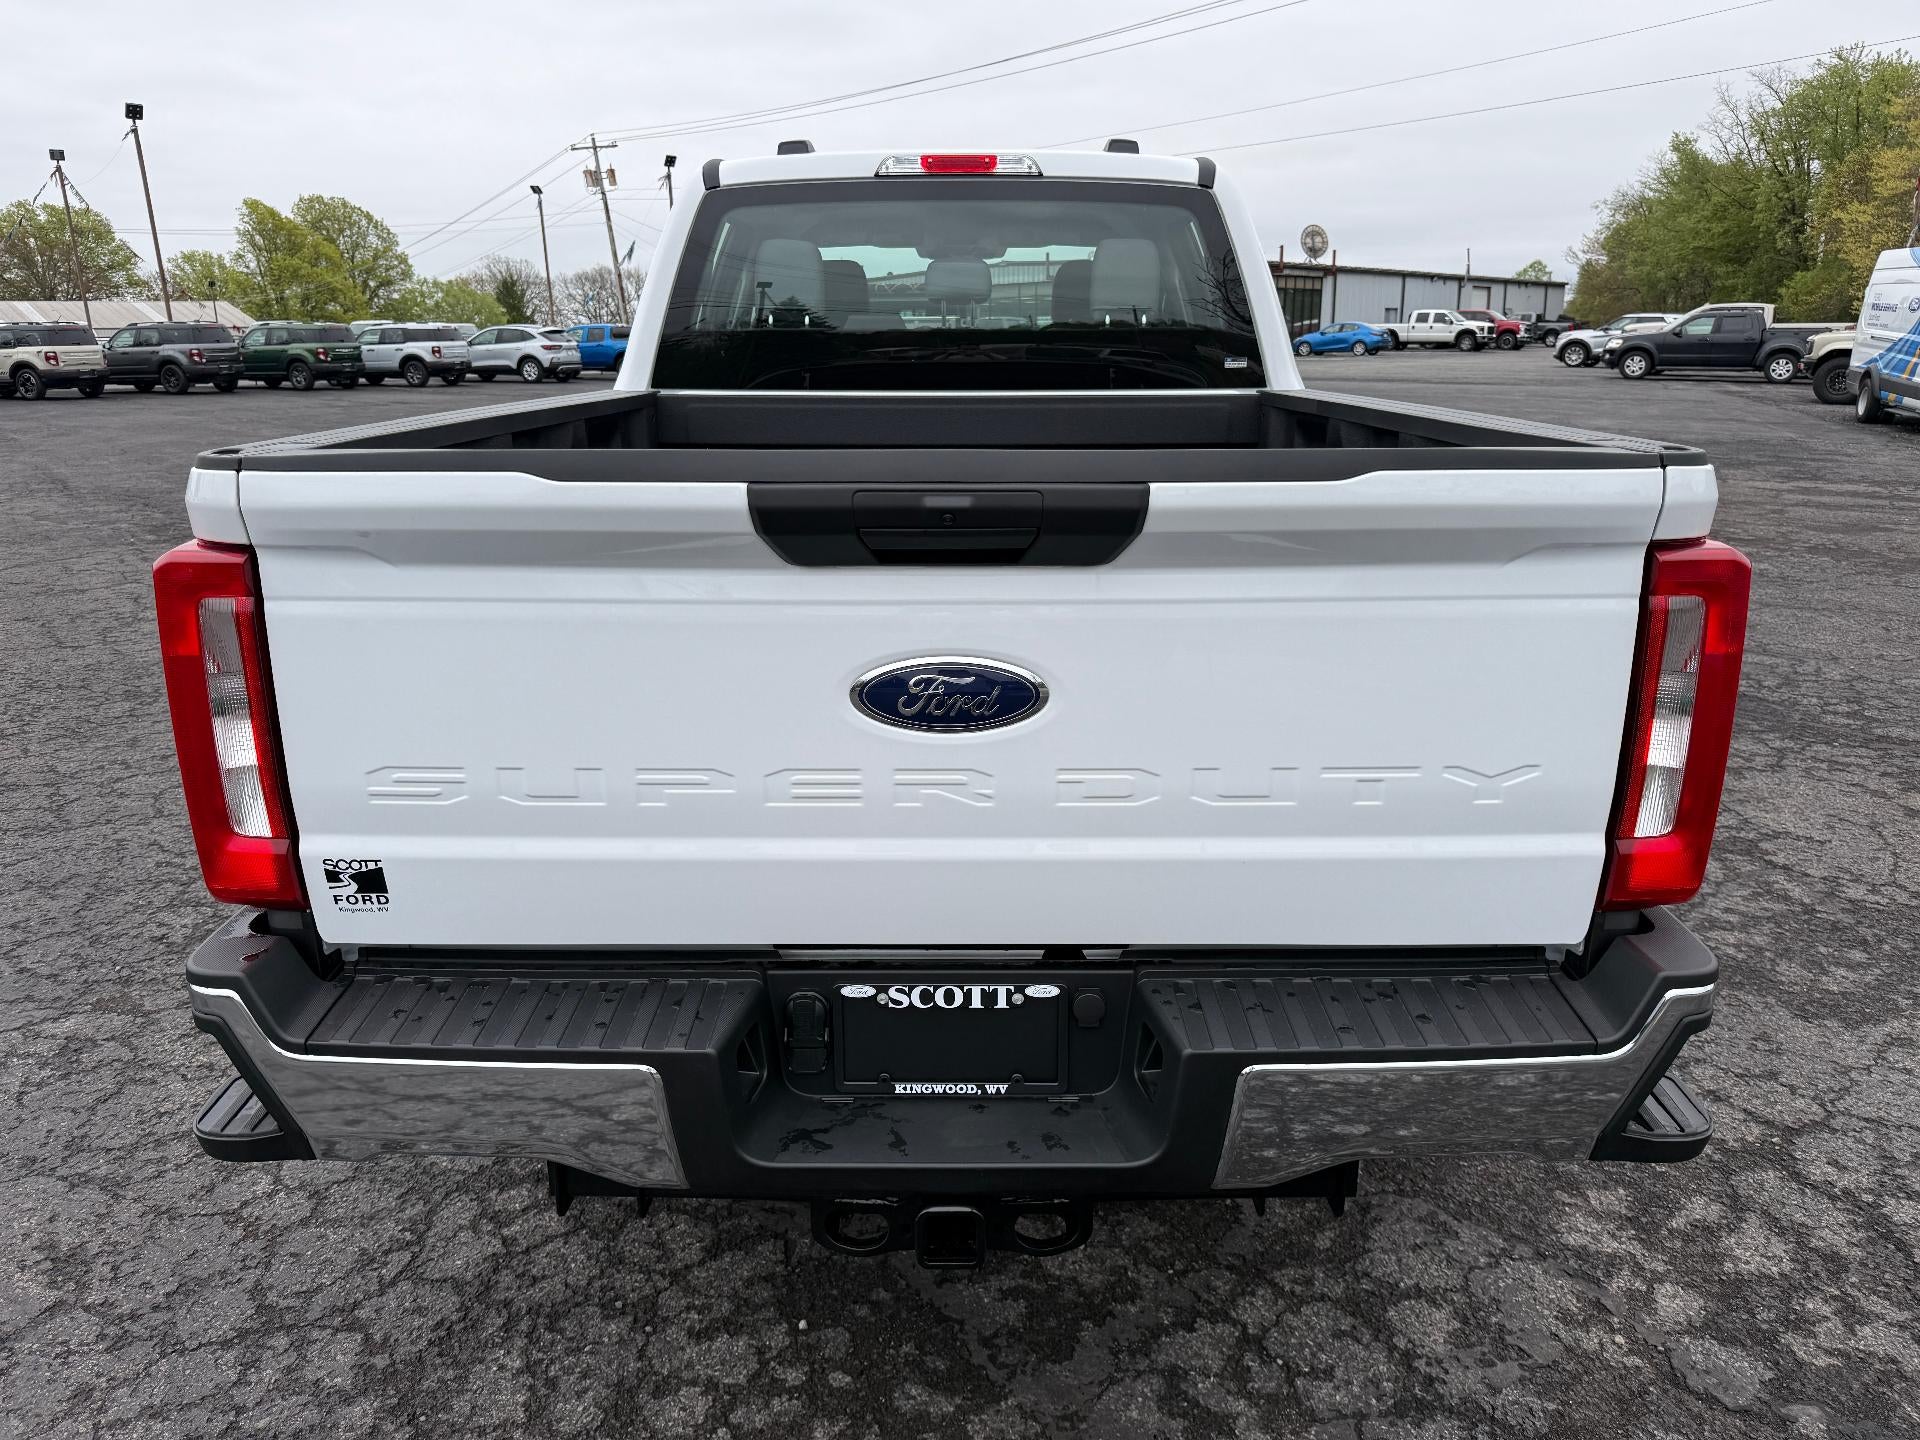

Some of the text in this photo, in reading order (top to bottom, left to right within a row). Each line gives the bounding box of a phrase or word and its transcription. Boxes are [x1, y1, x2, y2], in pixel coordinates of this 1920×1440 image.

[897, 674, 1002, 716] Ford
[364, 764, 1543, 806] SUPER DUTY
[322, 858, 383, 871] SCOTT
[332, 894, 390, 906] FORD
[338, 906, 376, 914] Kingwood,
[887, 985, 1015, 1009] SCOTT
[894, 1084, 1009, 1096] KINGWOOD, WV
